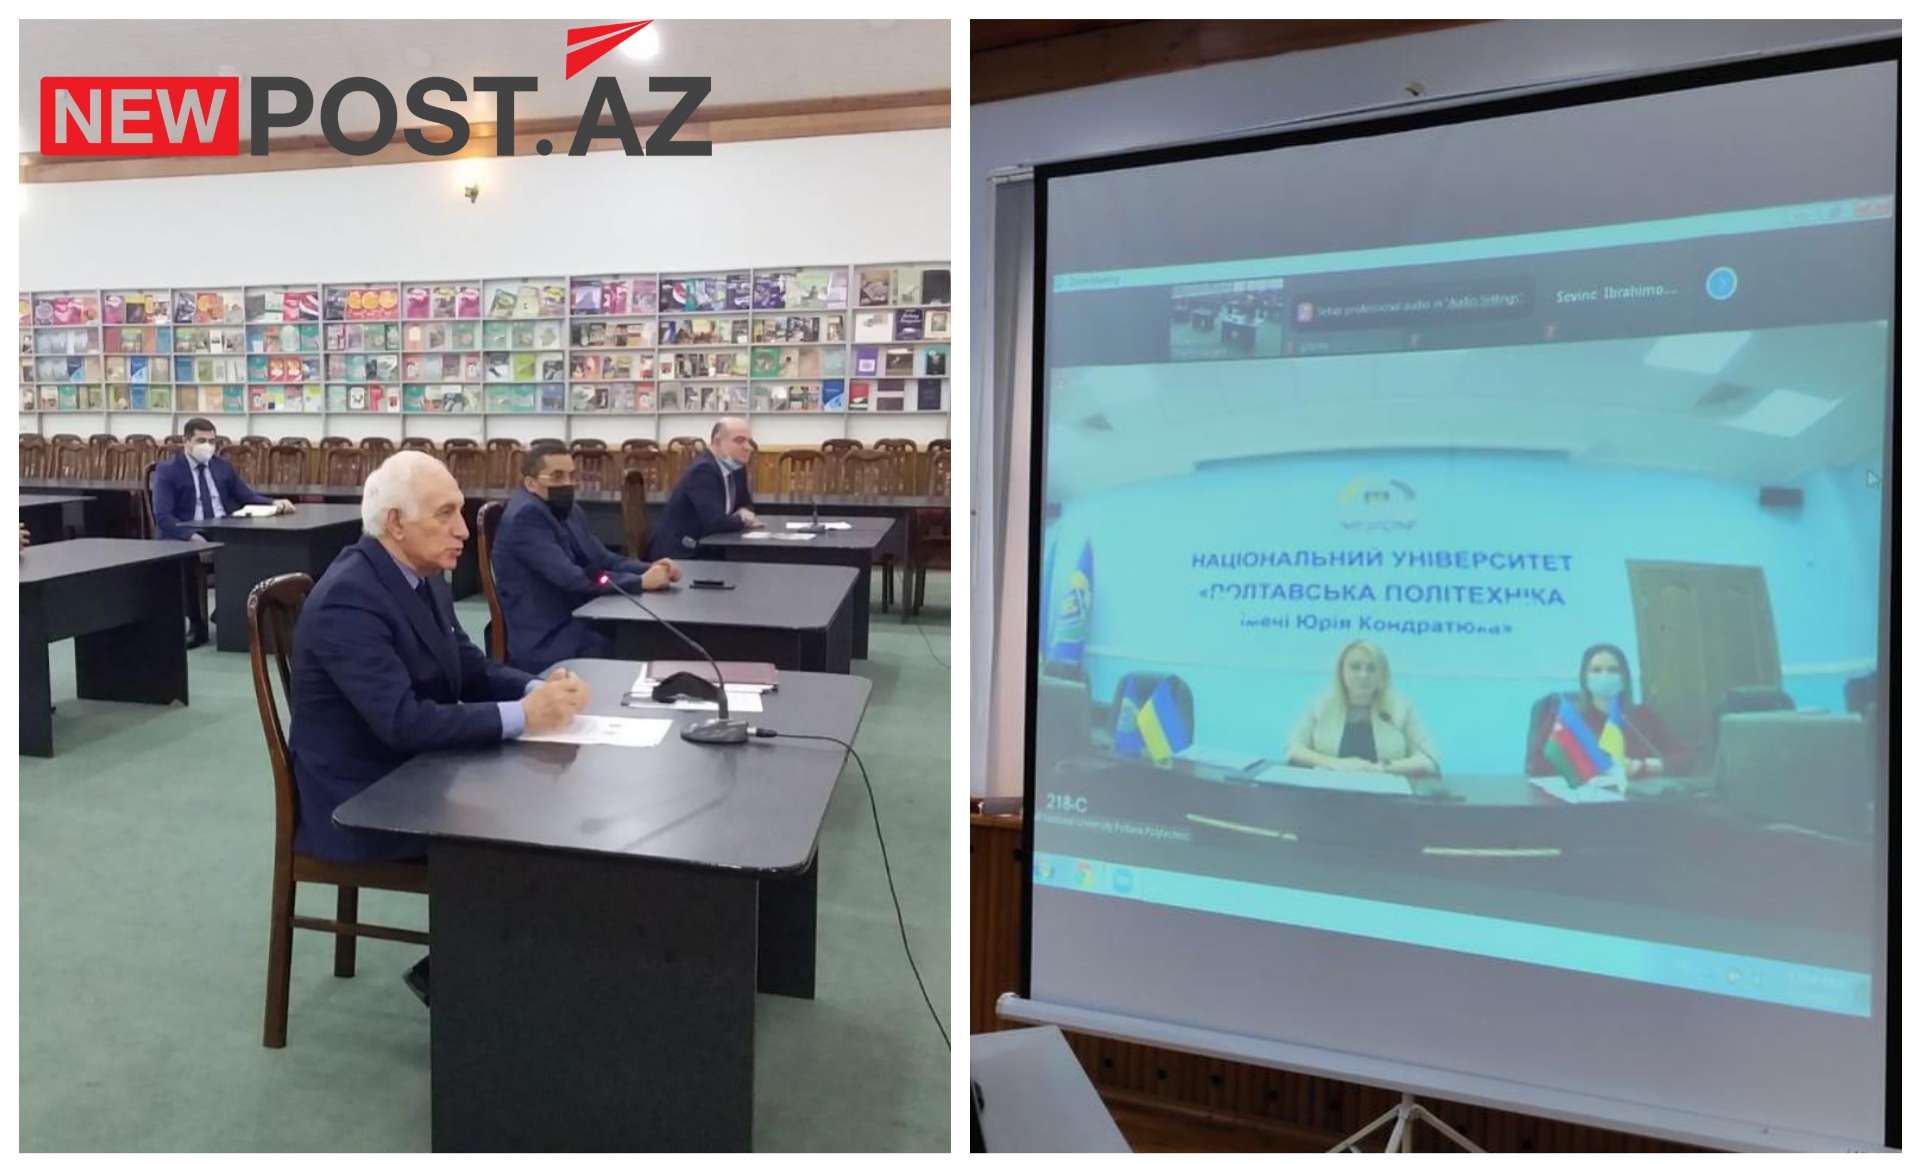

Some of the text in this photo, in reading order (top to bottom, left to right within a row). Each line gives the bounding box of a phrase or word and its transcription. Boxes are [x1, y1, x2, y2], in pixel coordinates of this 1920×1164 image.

[1191, 547, 1573, 572] НАЦІОНАЛЬНИЙ УНІВЕРСИТЕТ
[1296, 613, 1352, 633] Юрія
